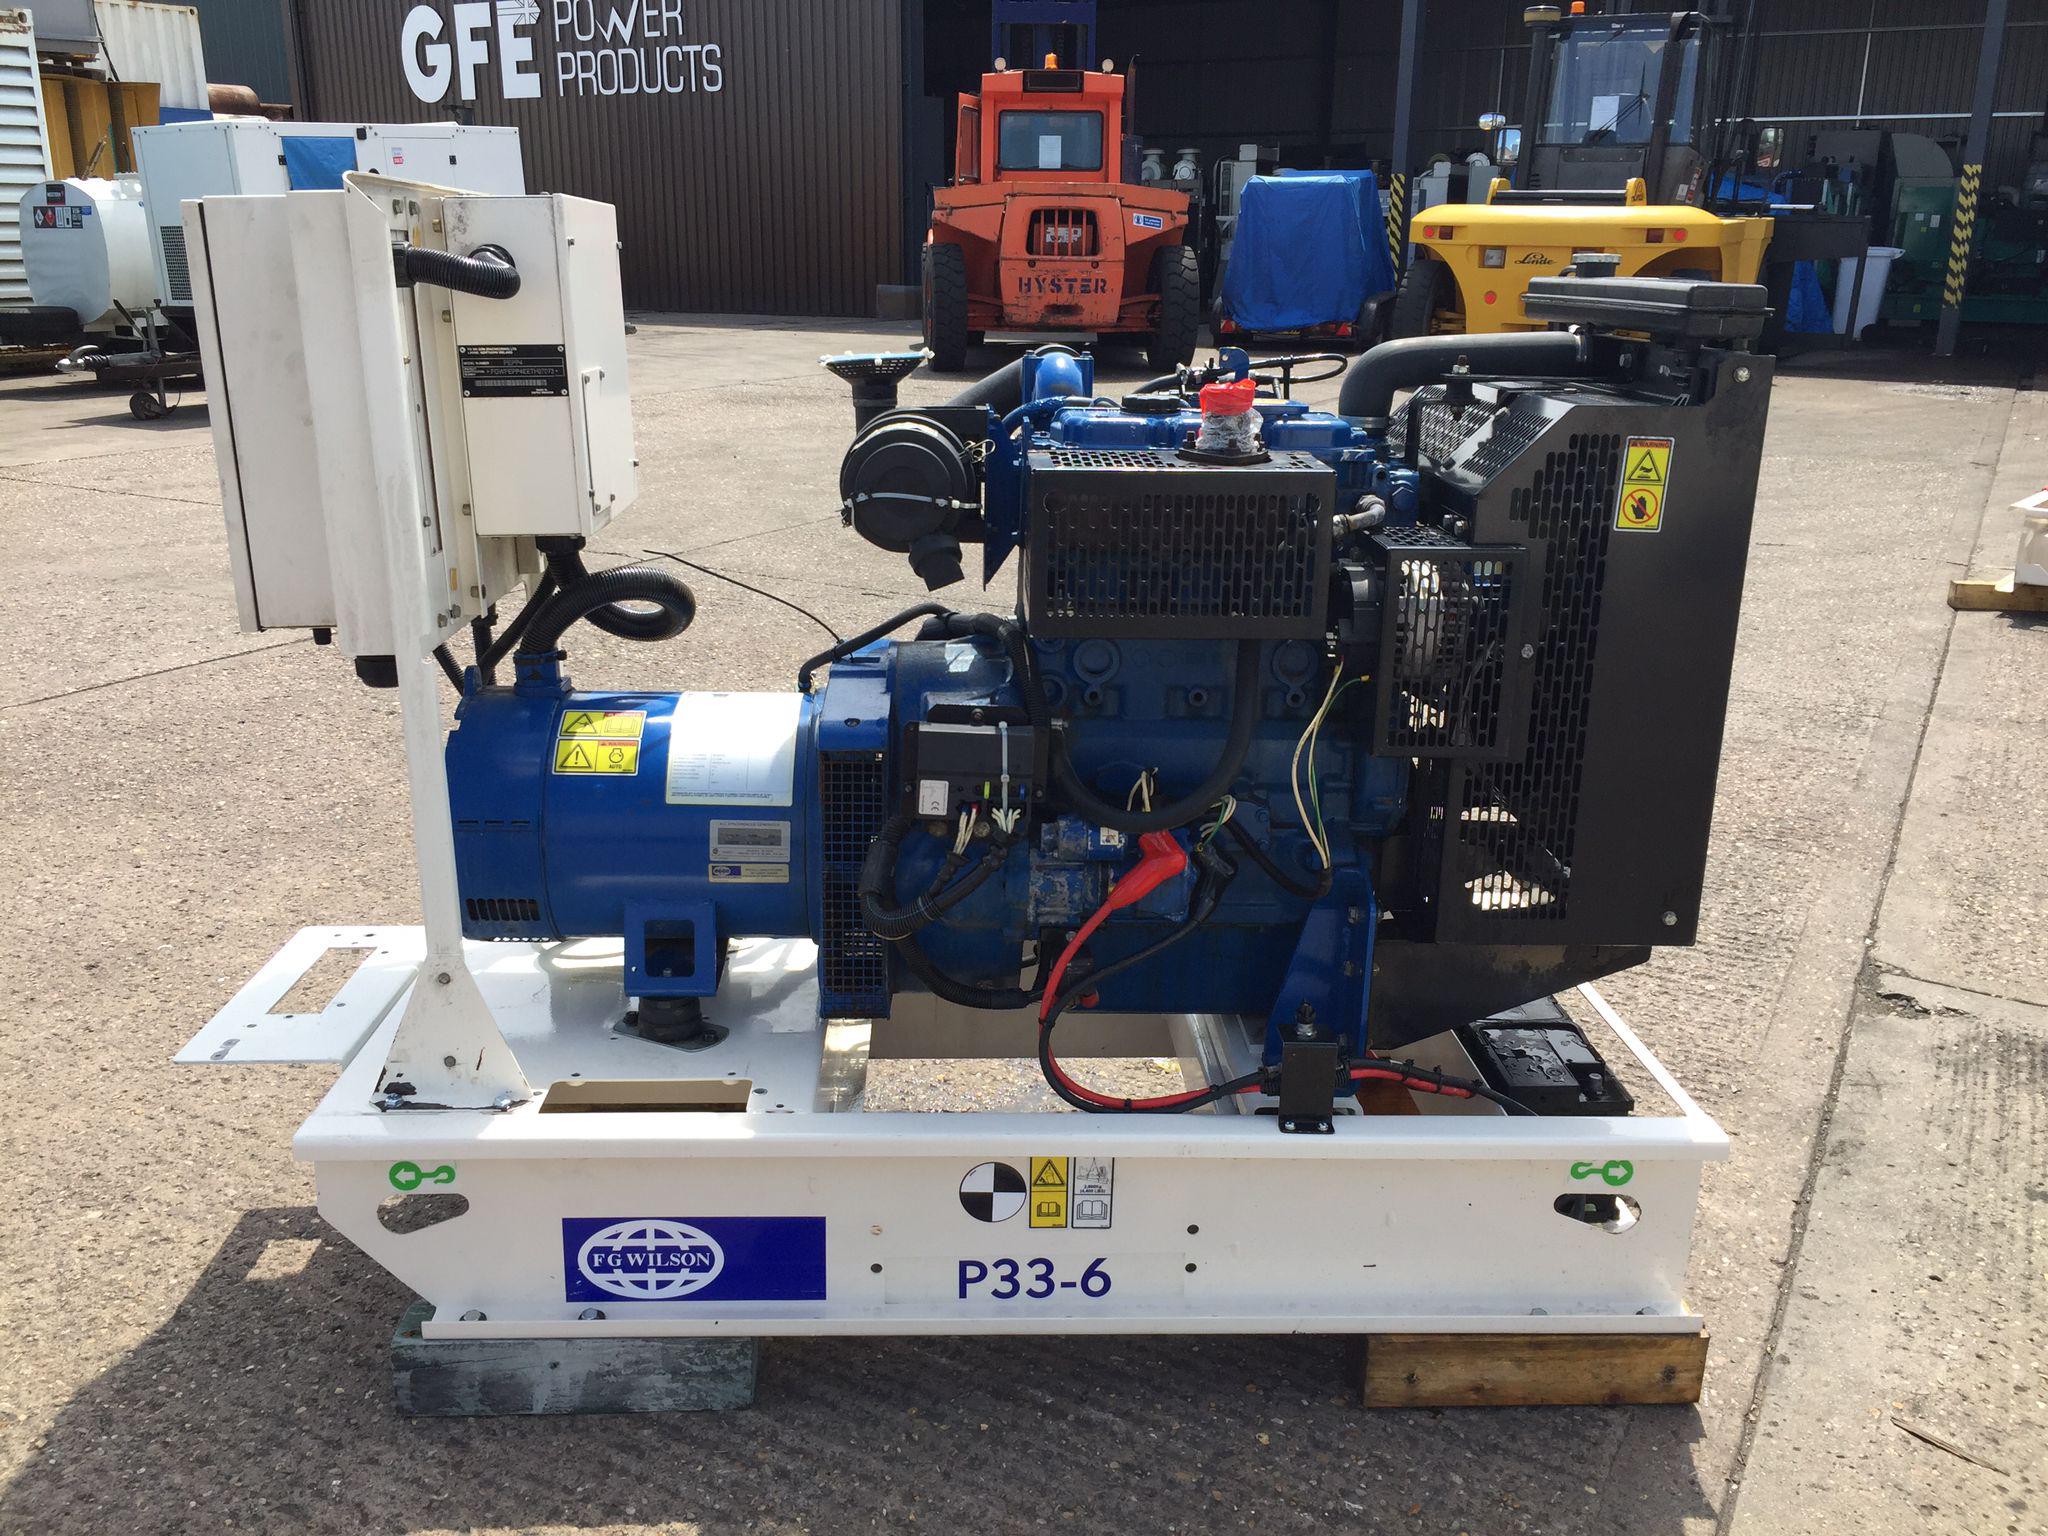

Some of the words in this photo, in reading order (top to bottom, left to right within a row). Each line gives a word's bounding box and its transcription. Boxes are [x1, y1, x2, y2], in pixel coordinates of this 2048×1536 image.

[553, 0, 683, 45] POWER
[401, 0, 541, 103] GFE
[556, 44, 722, 96] PRODUCTS
[1514, 252, 1556, 265] Linde
[1018, 277, 1107, 294] HYSTER
[593, 1253, 622, 1267] FG
[627, 1252, 711, 1267] WILSON
[958, 1257, 1112, 1299] P33-6
